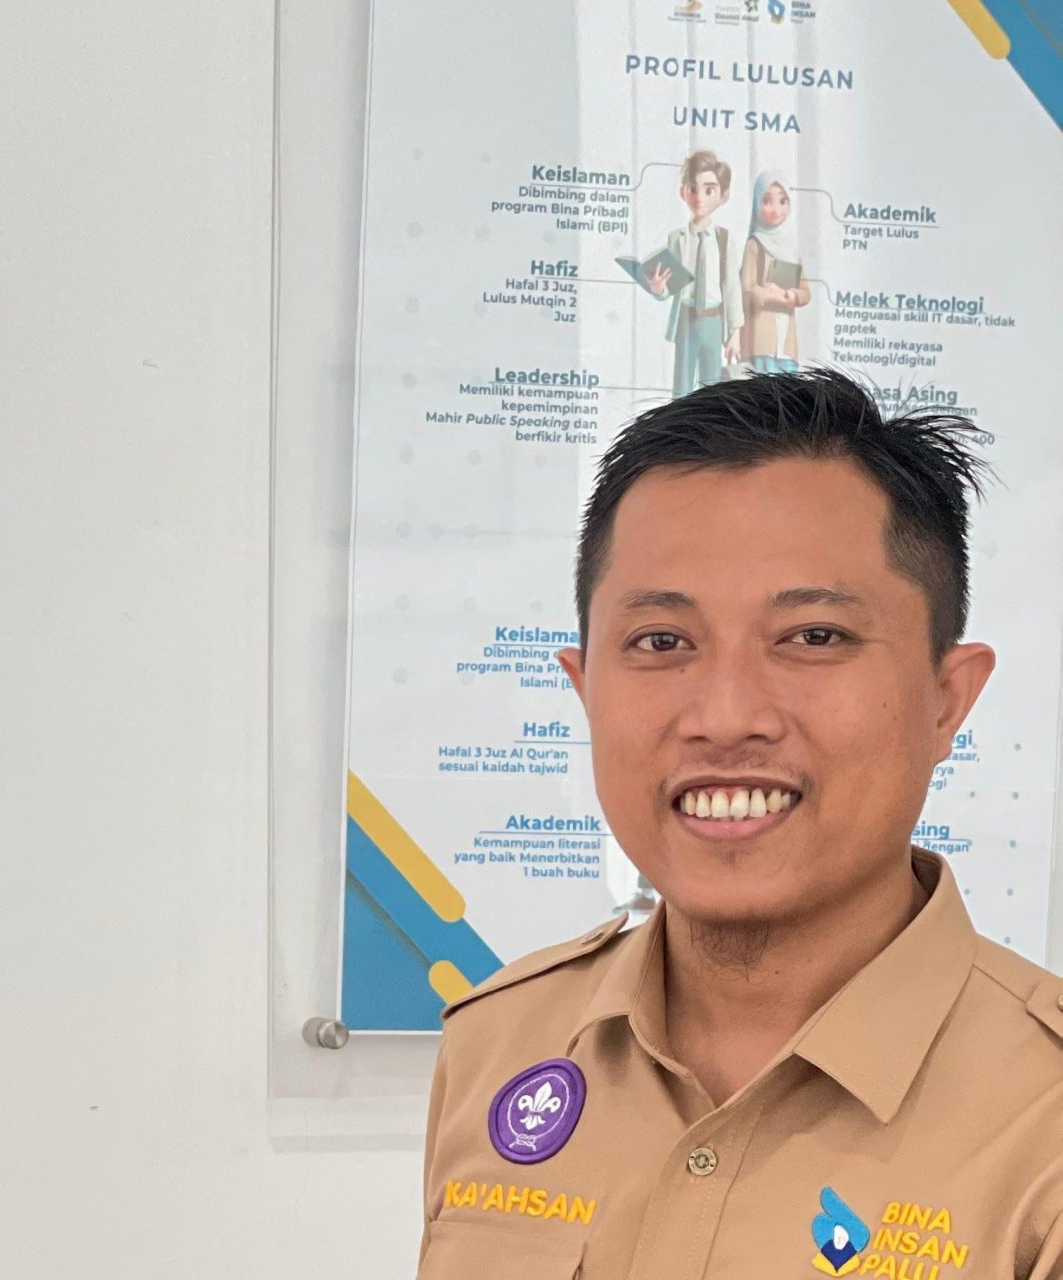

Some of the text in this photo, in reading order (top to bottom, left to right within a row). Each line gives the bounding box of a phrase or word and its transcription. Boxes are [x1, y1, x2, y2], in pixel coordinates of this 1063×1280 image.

[625, 54, 854, 90] PROFIL LULUSAN
[674, 106, 801, 133] UNIT SMA
[532, 165, 630, 186] Keislaman
[519, 186, 630, 204] Dibimbing dalam
[491, 202, 629, 218] program Bina Pribadi
[844, 203, 936, 223] Akademik
[556, 218, 629, 235] Islami (BPI)
[843, 224, 919, 239] Target Lulus
[842, 239, 868, 250] PTN
[531, 260, 579, 277] Hafiz
[506, 278, 578, 294] Hafal 3 Juz,
[483, 292, 577, 308] Lulus Mutqin 2
[836, 291, 984, 315] Melek Teknologi
[554, 311, 576, 322] Juz
[835, 308, 1016, 327] Menguasai skill IT dasar, tidak
[834, 322, 877, 335] gaptek
[833, 337, 943, 353] Memiliki rekayasa
[833, 351, 936, 367] Teknologi/digital
[494, 367, 600, 388] Leadership
[459, 383, 599, 401] Memiliki kemampuan
[869, 385, 958, 405] asa Asing
[501, 400, 598, 415] kepemimpinan
[426, 411, 598, 431] Mahir Public Speaking dan
[516, 430, 597, 444] berfikir kritis
[495, 626, 580, 643] Keislama
[483, 646, 549, 661] Dibimbing
[456, 662, 511, 674] program
[515, 662, 543, 673] Bina
[520, 677, 557, 688] Islami
[523, 722, 570, 737] Hafiz
[439, 746, 568, 760] Hafal 3 Juz Al Qur'an
[948, 752, 980, 763] asar,
[439, 761, 568, 775] sesuai kaidah tajwid
[505, 815, 601, 832] Akademik
[912, 820, 950, 840] sing
[474, 837, 600, 850] Kemampuan literasi
[924, 840, 969, 854] dengan
[454, 851, 600, 864] yang baik Menerbitkan
[523, 866, 599, 878] 1 buah buku
[444, 1180, 596, 1225] KA'AHSAN
[882, 1201, 951, 1234] BINA
[872, 1228, 969, 1269] INSAN
